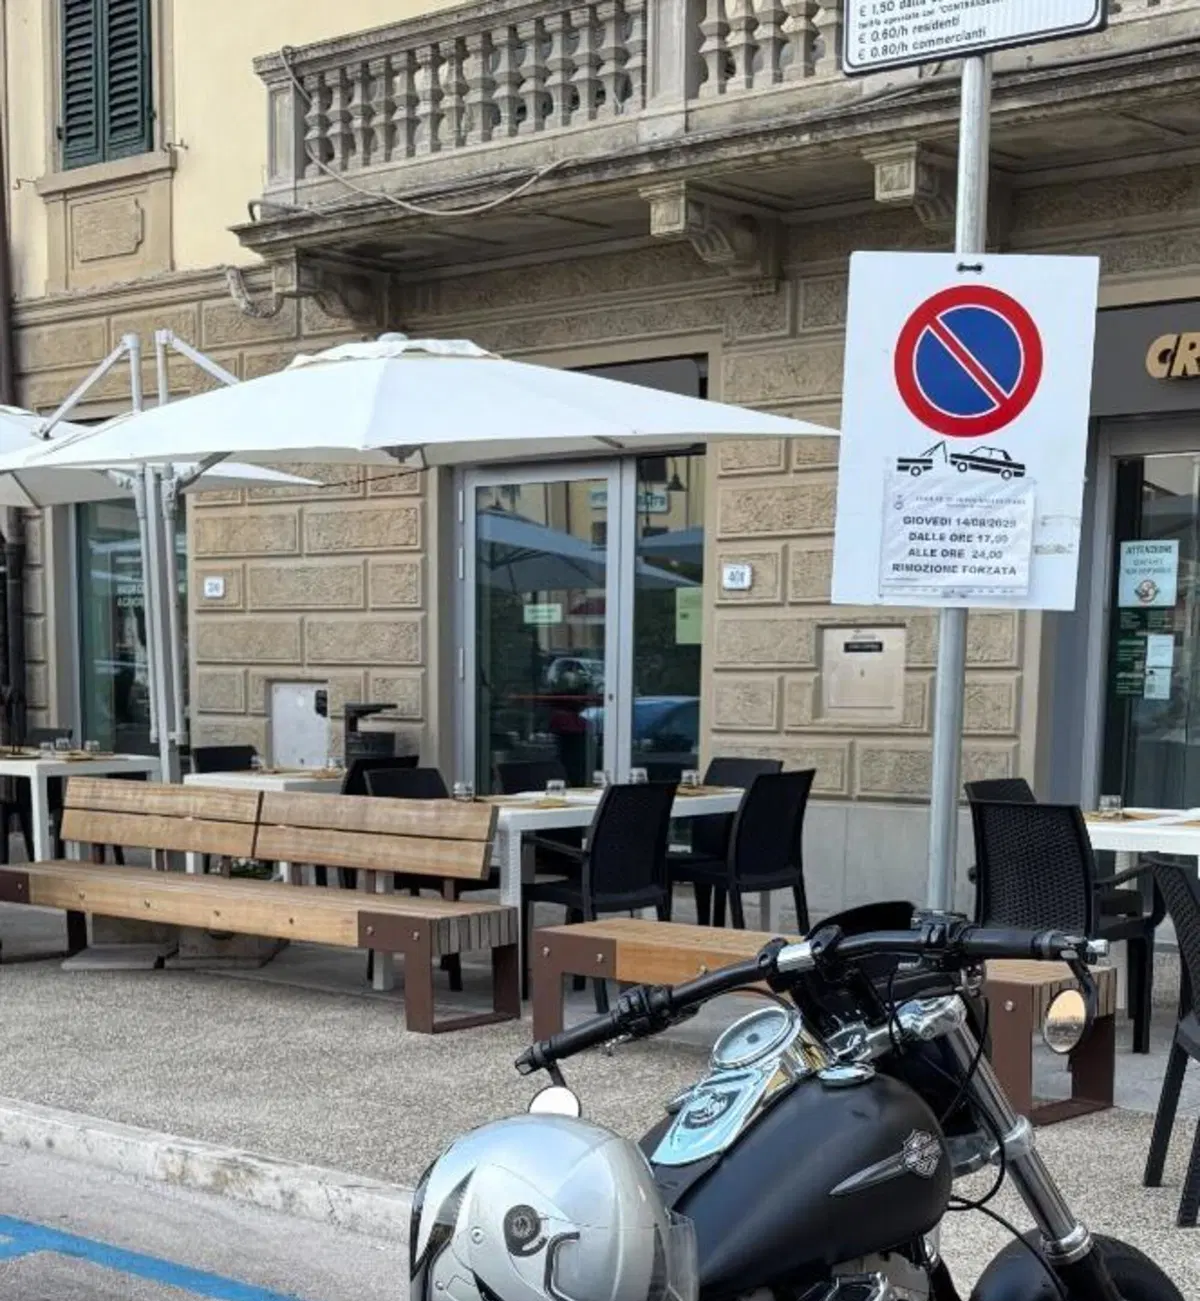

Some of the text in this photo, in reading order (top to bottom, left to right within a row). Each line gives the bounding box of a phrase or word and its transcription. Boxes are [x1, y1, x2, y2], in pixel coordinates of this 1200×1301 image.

[858, 32, 866, 44] €
[912, 15, 960, 34] residenti
[858, 48, 866, 60] €
[912, 27, 986, 50] commercianti
[908, 532, 946, 542] DALLE
[949, 534, 973, 543] ORE
[908, 548, 937, 558] ALLE
[941, 549, 965, 559] ORE
[892, 563, 1017, 576] RIMOZIONE FORZATA
